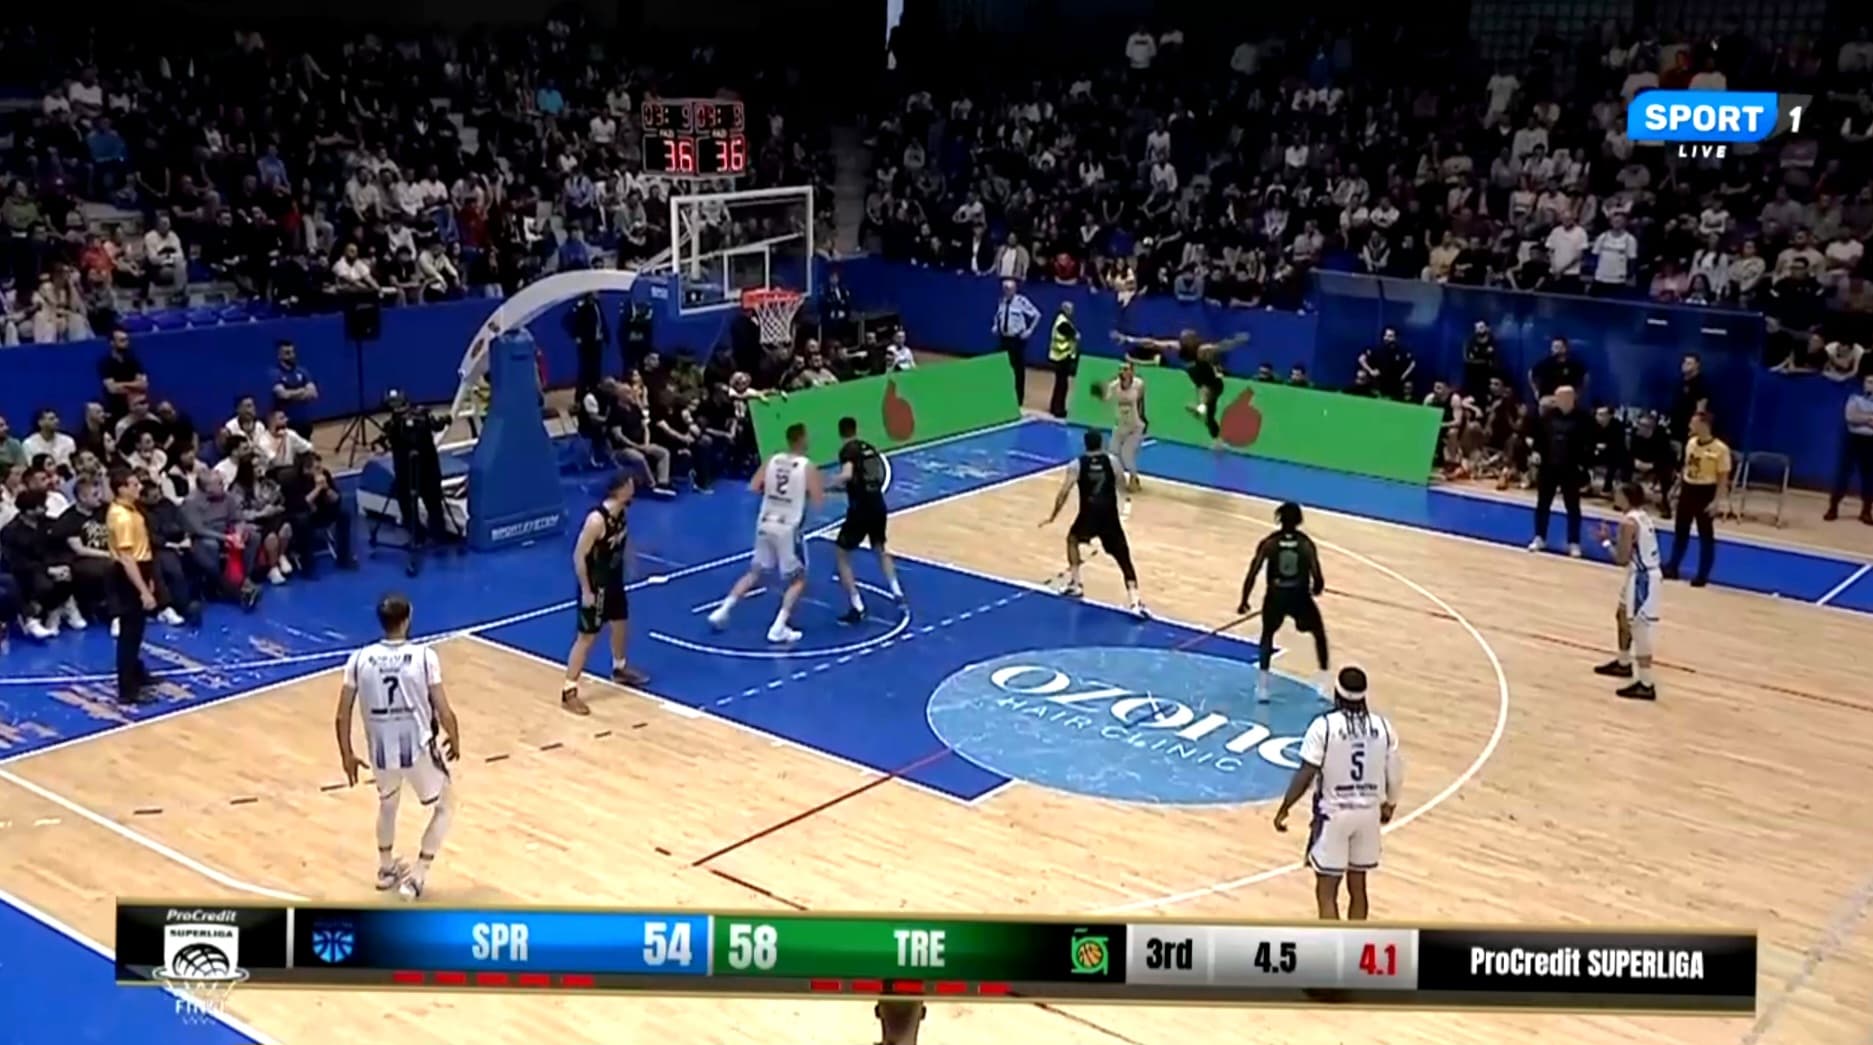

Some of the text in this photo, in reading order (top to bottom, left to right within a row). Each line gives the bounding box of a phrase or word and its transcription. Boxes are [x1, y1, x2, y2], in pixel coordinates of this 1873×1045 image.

[663, 140, 693, 172] 36
[715, 139, 743, 171] 36
[382, 675, 399, 706] 7
[996, 697, 1243, 771] HAIR CLINIC
[1350, 750, 1366, 782] 5
